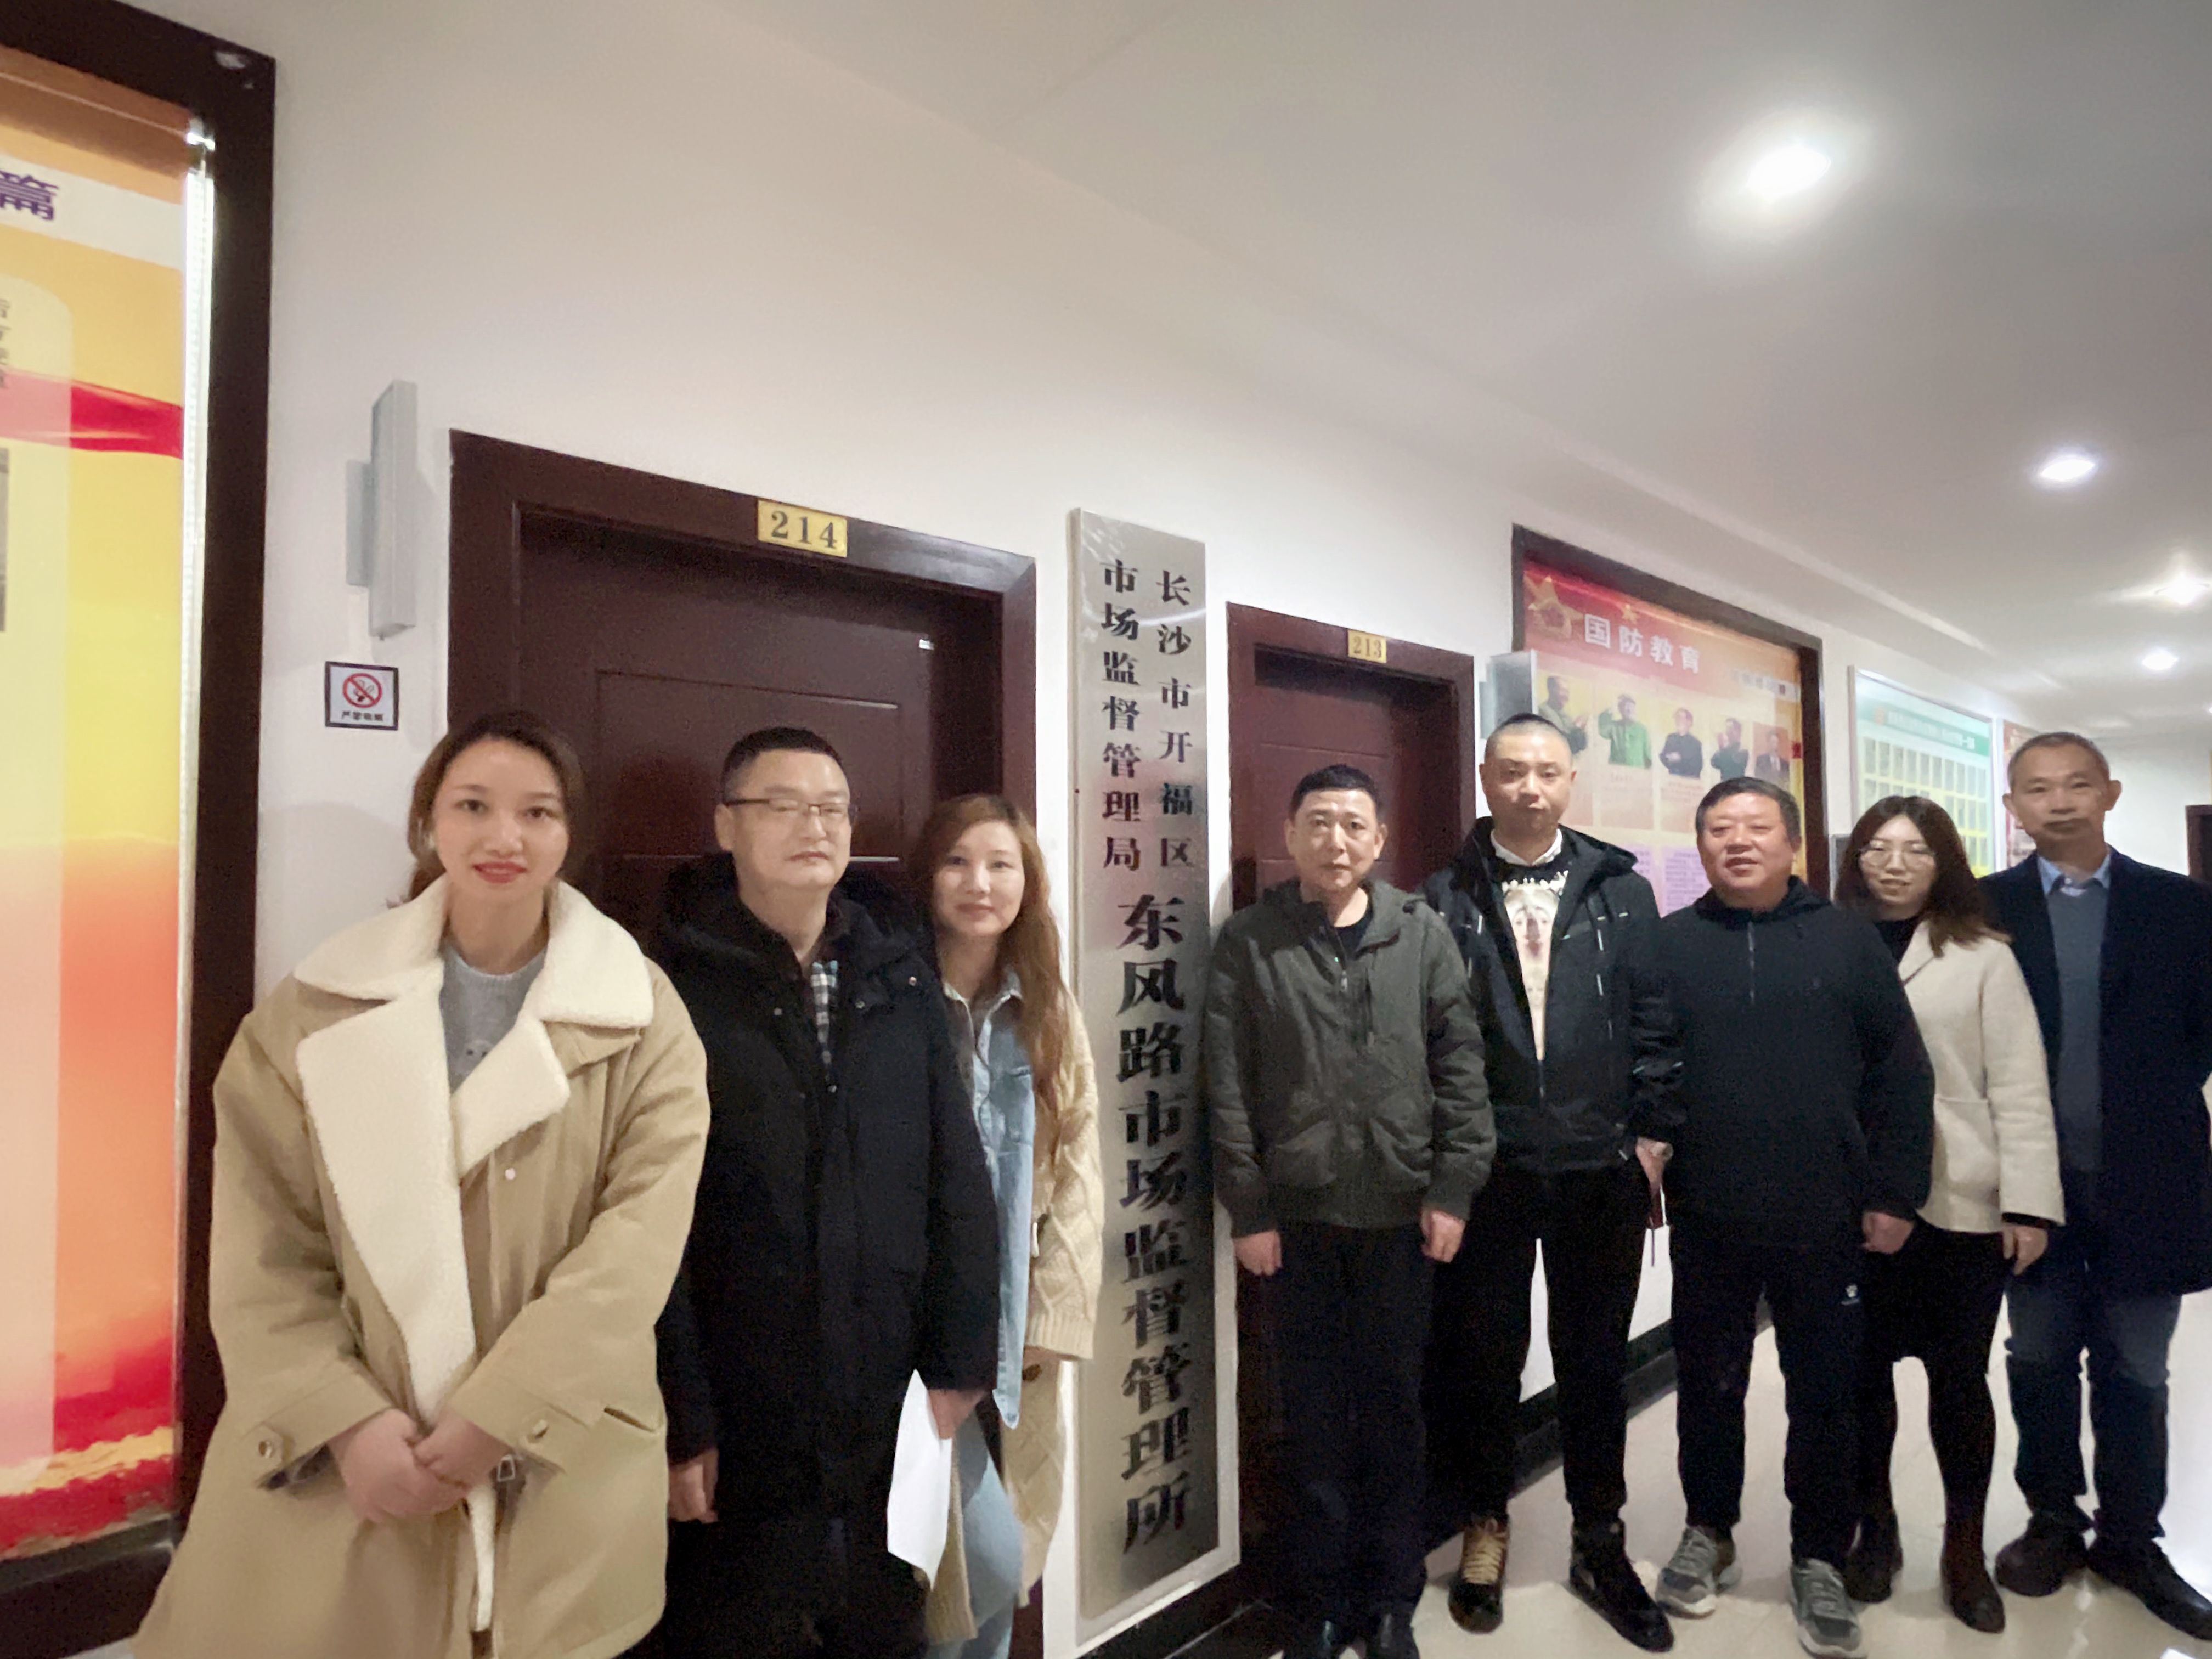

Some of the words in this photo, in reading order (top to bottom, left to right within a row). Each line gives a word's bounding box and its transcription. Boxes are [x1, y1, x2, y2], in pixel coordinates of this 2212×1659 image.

[771, 511, 837, 549] 214
[1099, 559, 1141, 872] 市场监督管理局
[1156, 570, 1193, 867] 长沙市开福区
[1353, 636, 1381, 658] 213
[1584, 613, 1700, 674] 国防教育
[1116, 894, 1192, 1554] 东风路市场监督管理所
